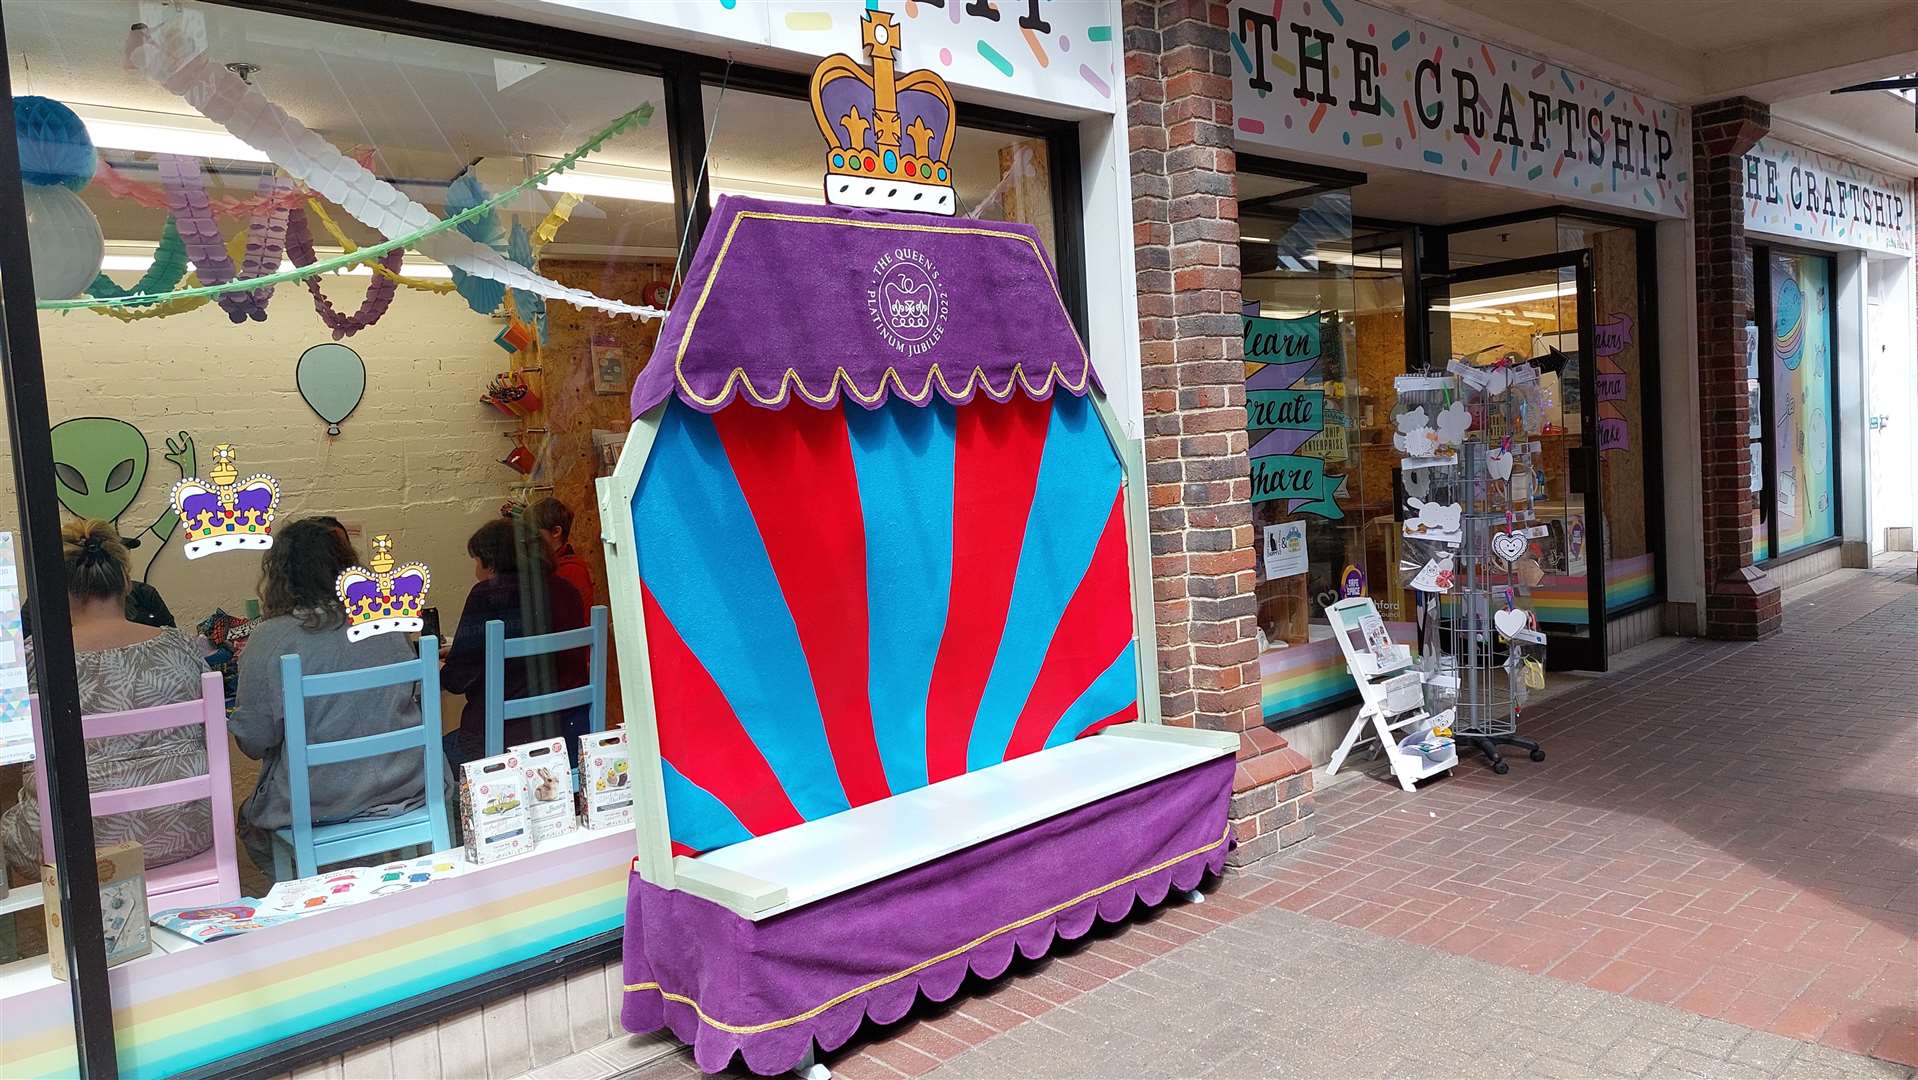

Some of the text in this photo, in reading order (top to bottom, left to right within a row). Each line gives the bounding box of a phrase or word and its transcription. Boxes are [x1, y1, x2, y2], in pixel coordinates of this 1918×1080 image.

[1238, 7, 1672, 181] THE CRAFTSHIP
[1745, 154, 1903, 231] HE CRAFTSHIP
[873, 248, 940, 280] THE QUEEN'S
[867, 289, 949, 357] PLATINUM JUBILEE 2022
[1595, 329, 1622, 350] akers
